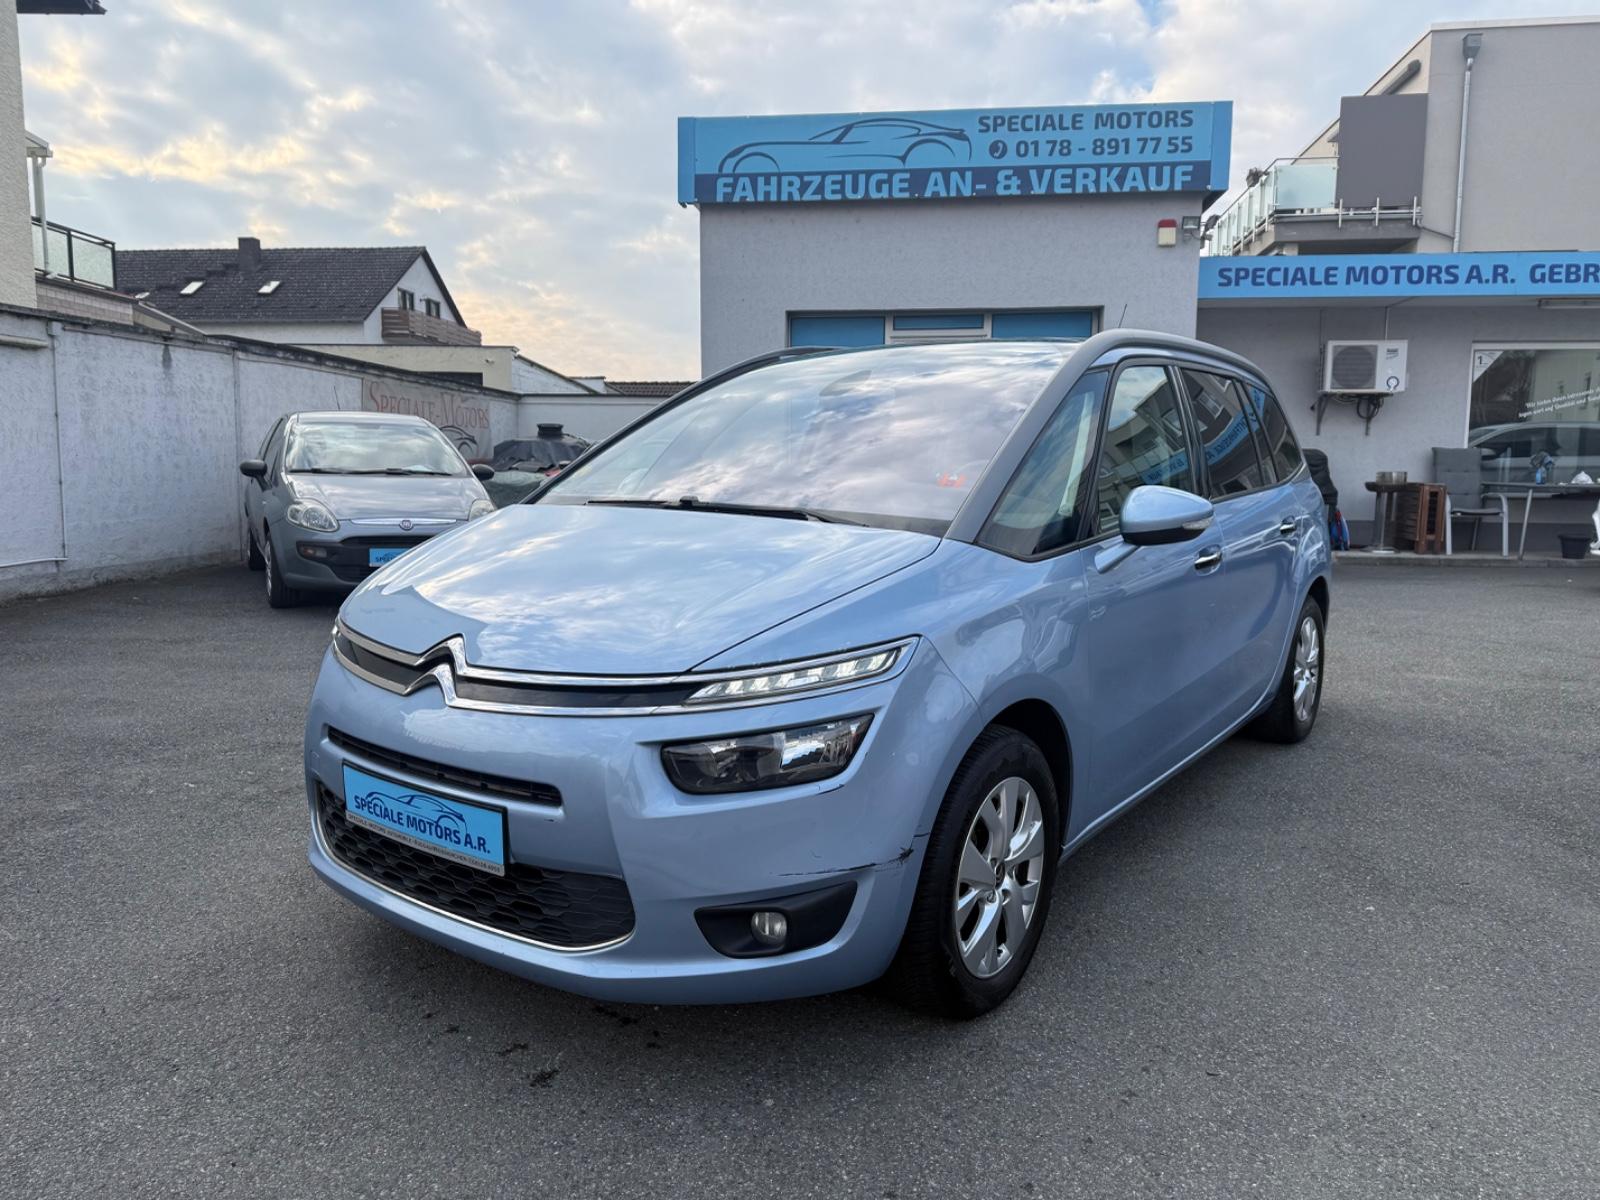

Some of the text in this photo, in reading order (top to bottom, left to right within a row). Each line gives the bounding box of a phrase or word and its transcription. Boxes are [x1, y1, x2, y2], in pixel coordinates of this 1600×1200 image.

[978, 109, 1194, 133] SPECIALE MOTORS
[716, 164, 1194, 203] FAHRZEUGE AN- & VERKAUF
[1217, 266, 1339, 288] SPECIALE
[1345, 264, 1460, 286] MOTORS
[1464, 263, 1516, 285] A.R.
[354, 795, 404, 826] SPECIALE
[406, 813, 462, 845] MOTORS
[464, 833, 491, 854] A.R.
